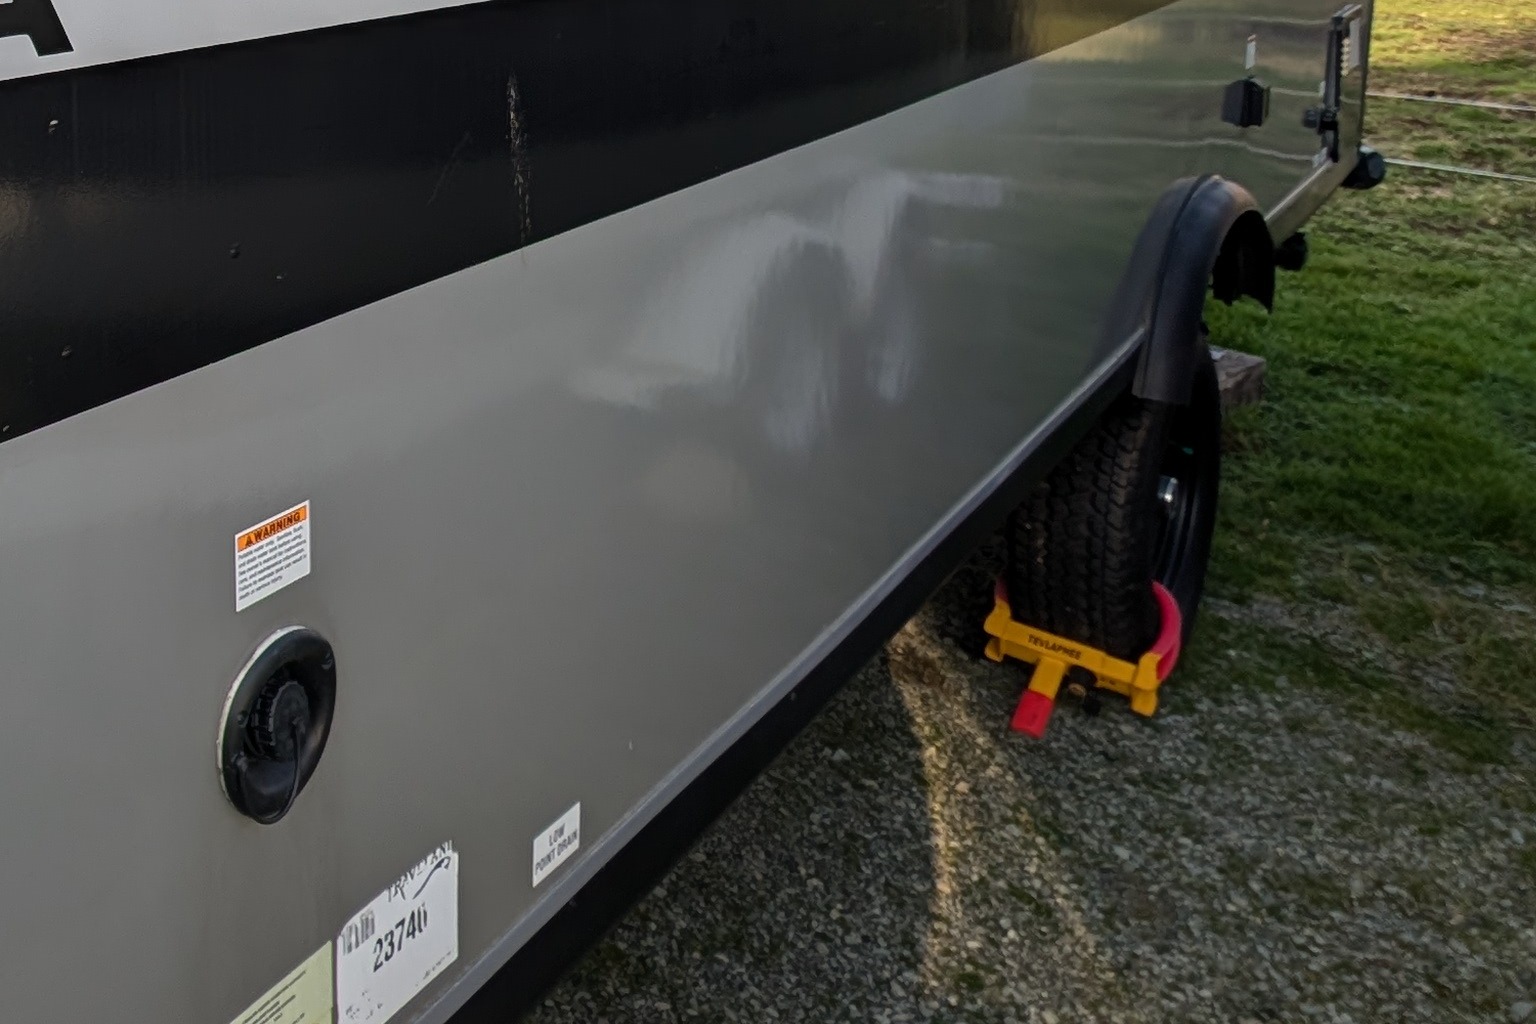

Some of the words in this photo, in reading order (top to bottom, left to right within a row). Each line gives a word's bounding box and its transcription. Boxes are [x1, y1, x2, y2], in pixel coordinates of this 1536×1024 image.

[254, 511, 301, 542] WARNING
[548, 823, 566, 847] LOW
[535, 847, 557, 876] POINT
[556, 828, 579, 857] DRAIN
